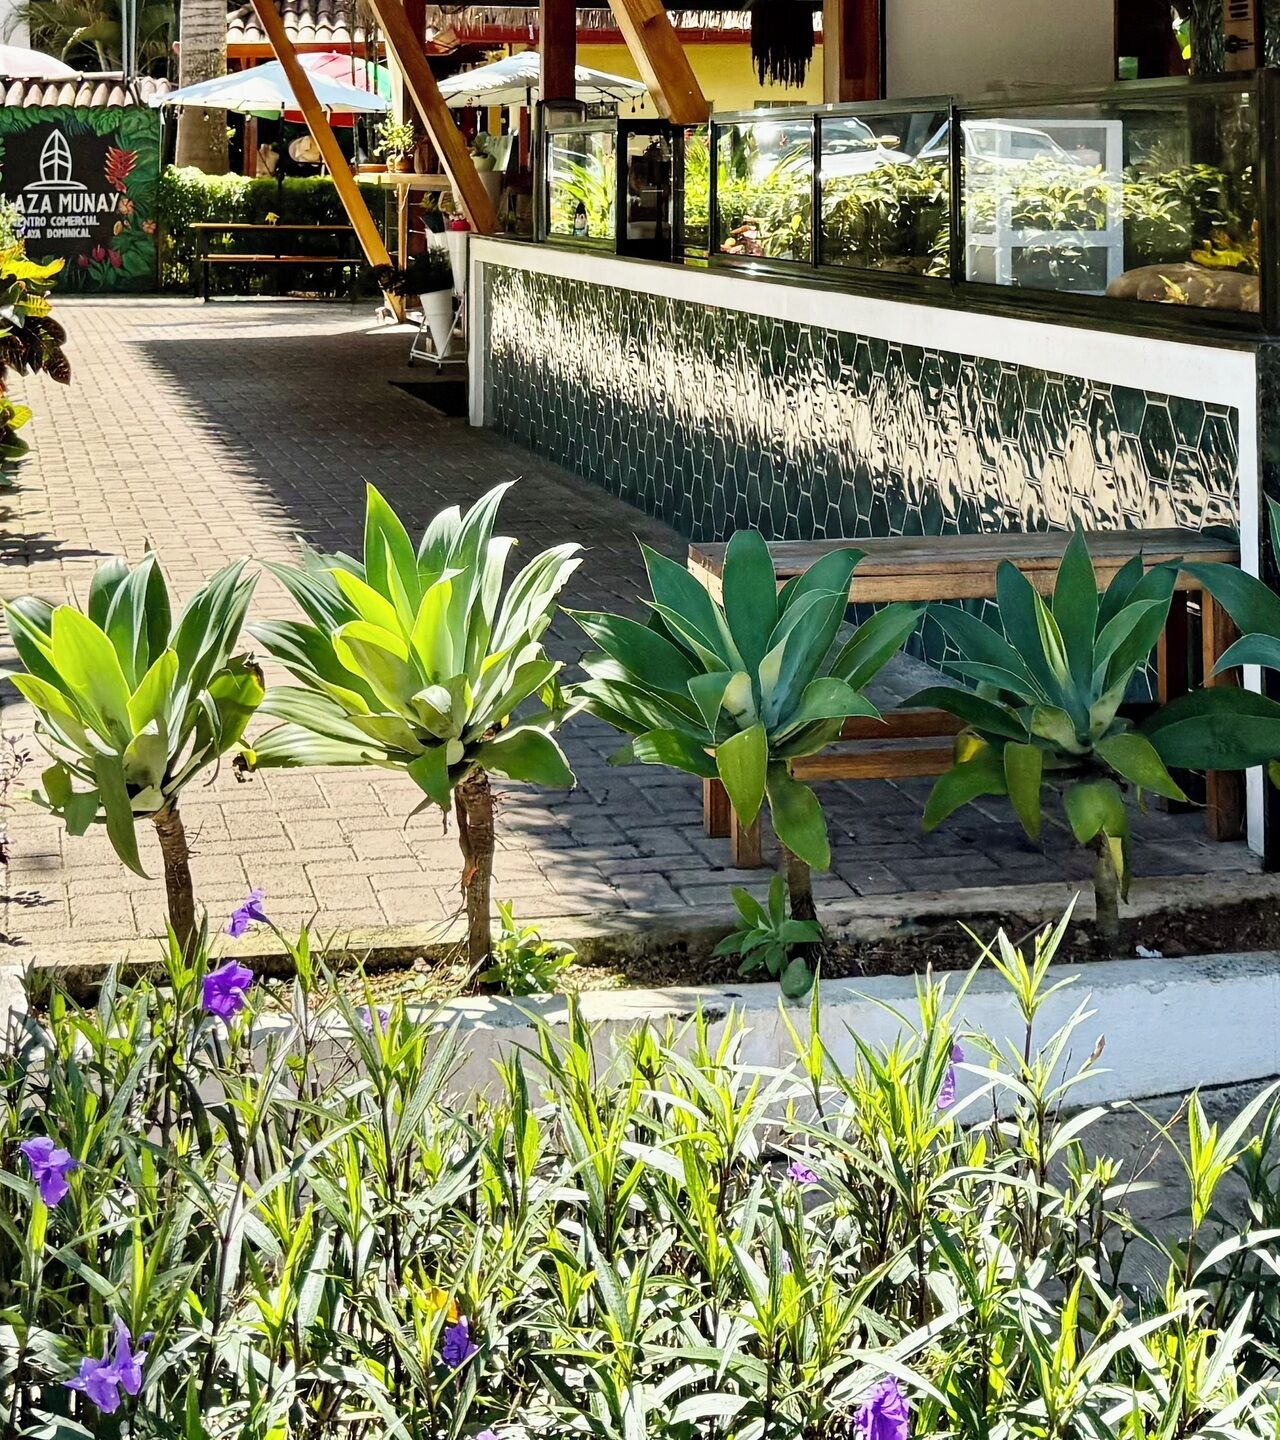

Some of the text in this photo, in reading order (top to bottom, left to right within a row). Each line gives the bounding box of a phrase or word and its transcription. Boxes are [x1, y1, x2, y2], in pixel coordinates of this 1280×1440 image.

[58, 192, 120, 214] MUNAY
[50, 215, 100, 227] COMERCIAL
[46, 227, 92, 239] DOMINICAL
